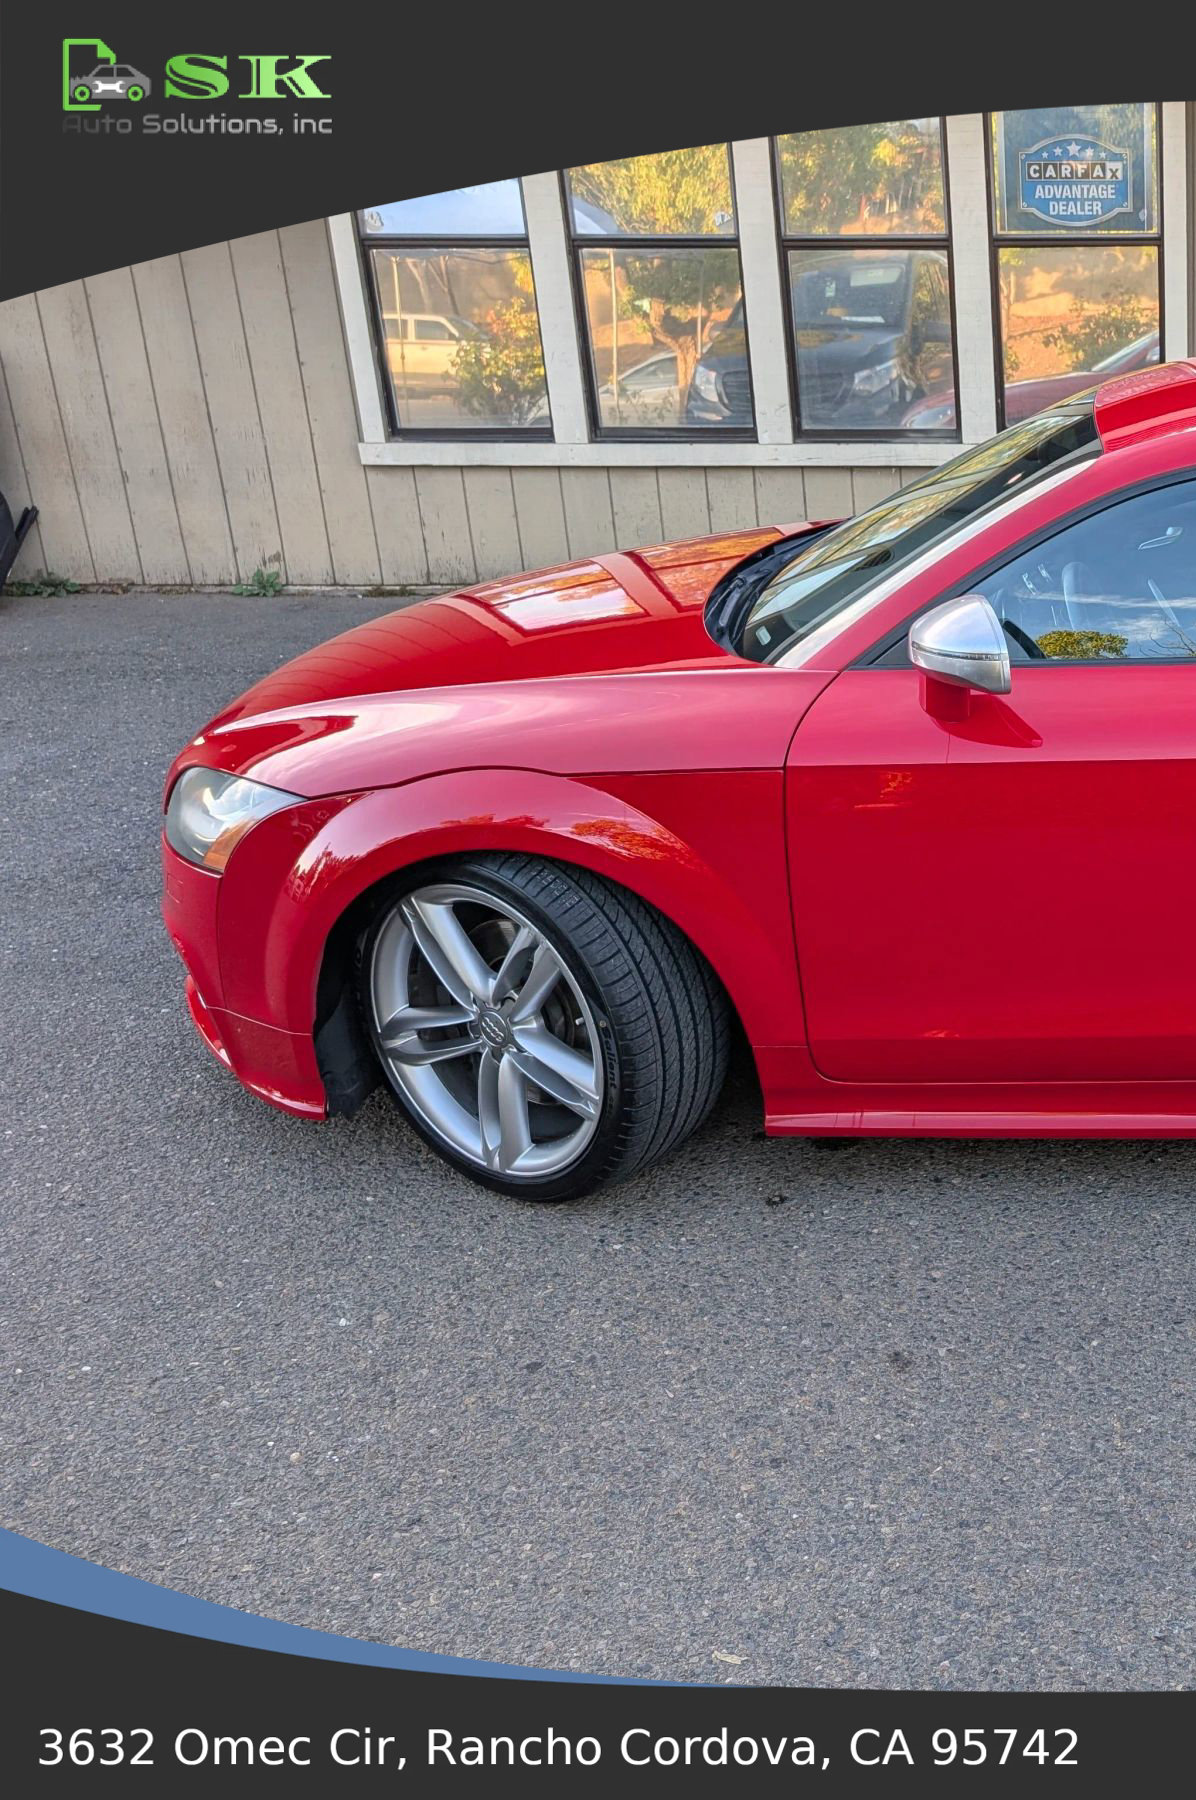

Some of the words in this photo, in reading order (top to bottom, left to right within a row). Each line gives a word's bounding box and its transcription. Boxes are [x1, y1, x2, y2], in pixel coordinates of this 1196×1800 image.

[1028, 163, 1120, 180] CARFAX
[1034, 184, 1116, 199] ADVANTAGE
[1049, 201, 1102, 216] DEALER
